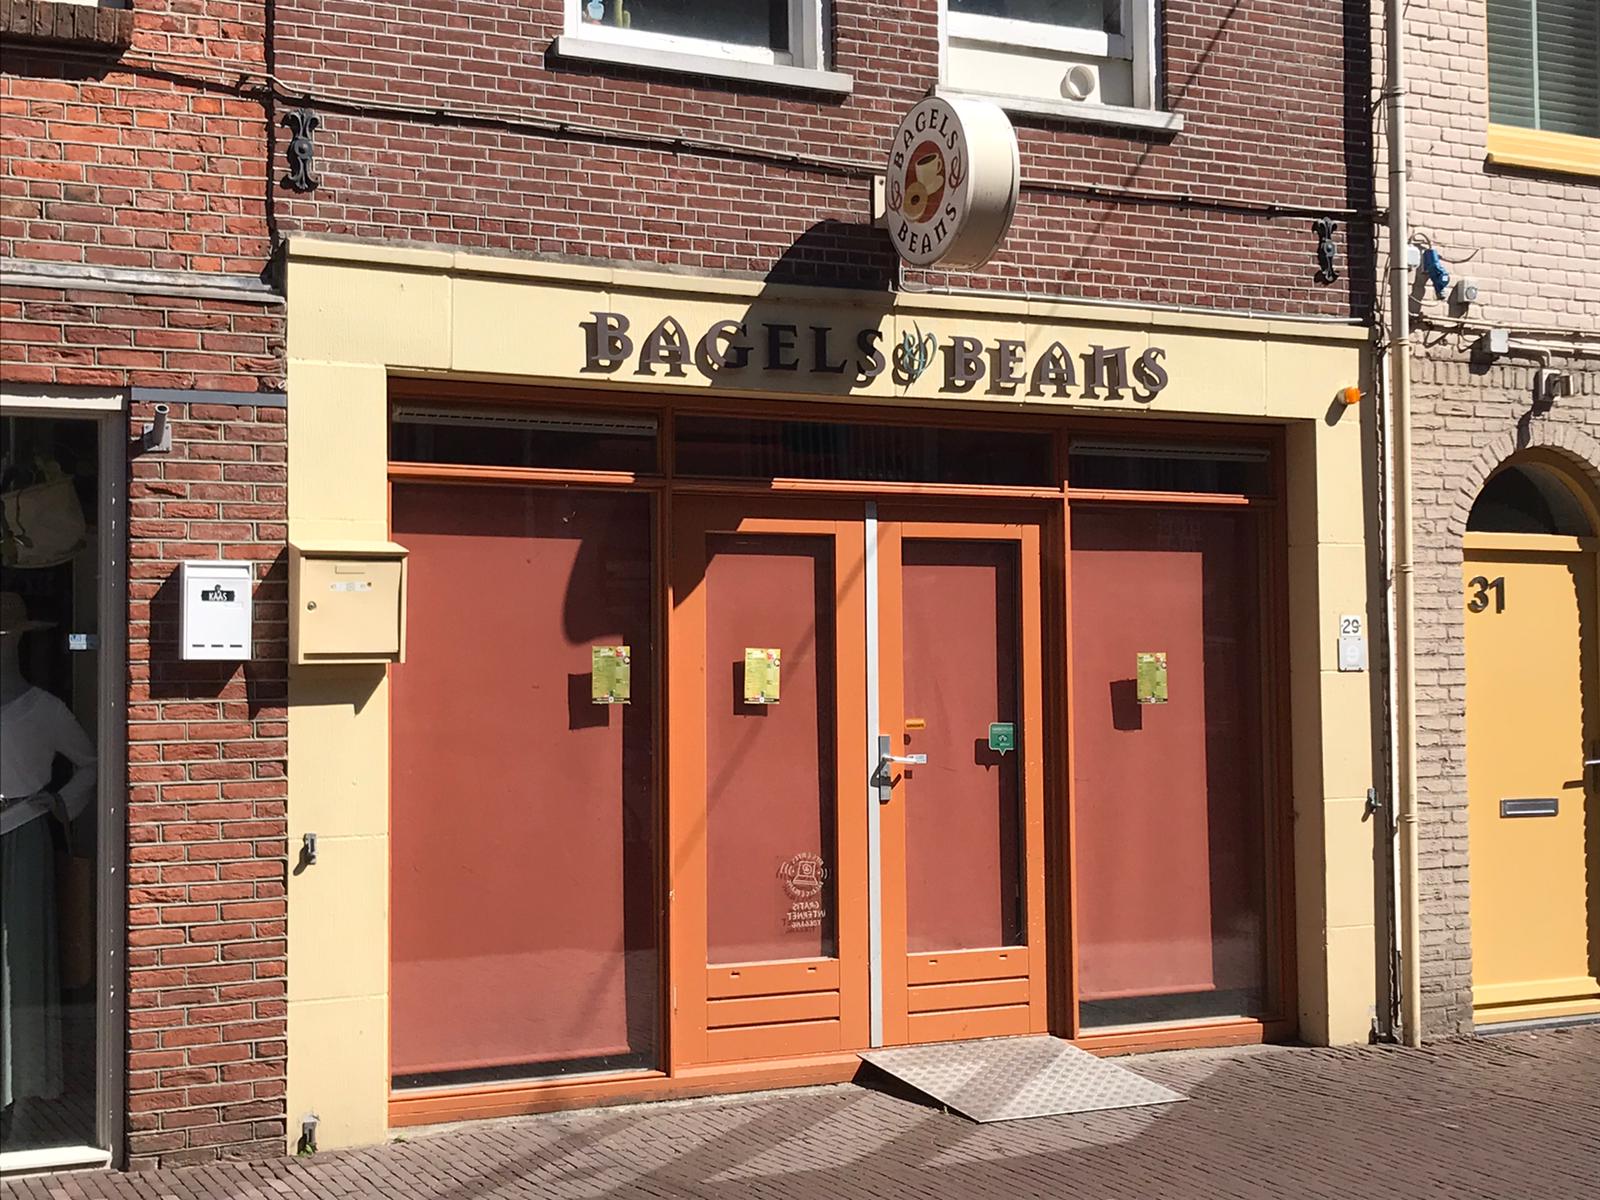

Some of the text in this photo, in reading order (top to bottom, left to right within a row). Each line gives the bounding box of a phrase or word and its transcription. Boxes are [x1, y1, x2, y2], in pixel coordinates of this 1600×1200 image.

[894, 109, 959, 169] BAGELS
[897, 202, 957, 254] BEANS
[588, 310, 887, 382] BAGELS
[944, 335, 1169, 395] BEANS
[1467, 576, 1506, 614] 31
[1342, 619, 1360, 634] 29
